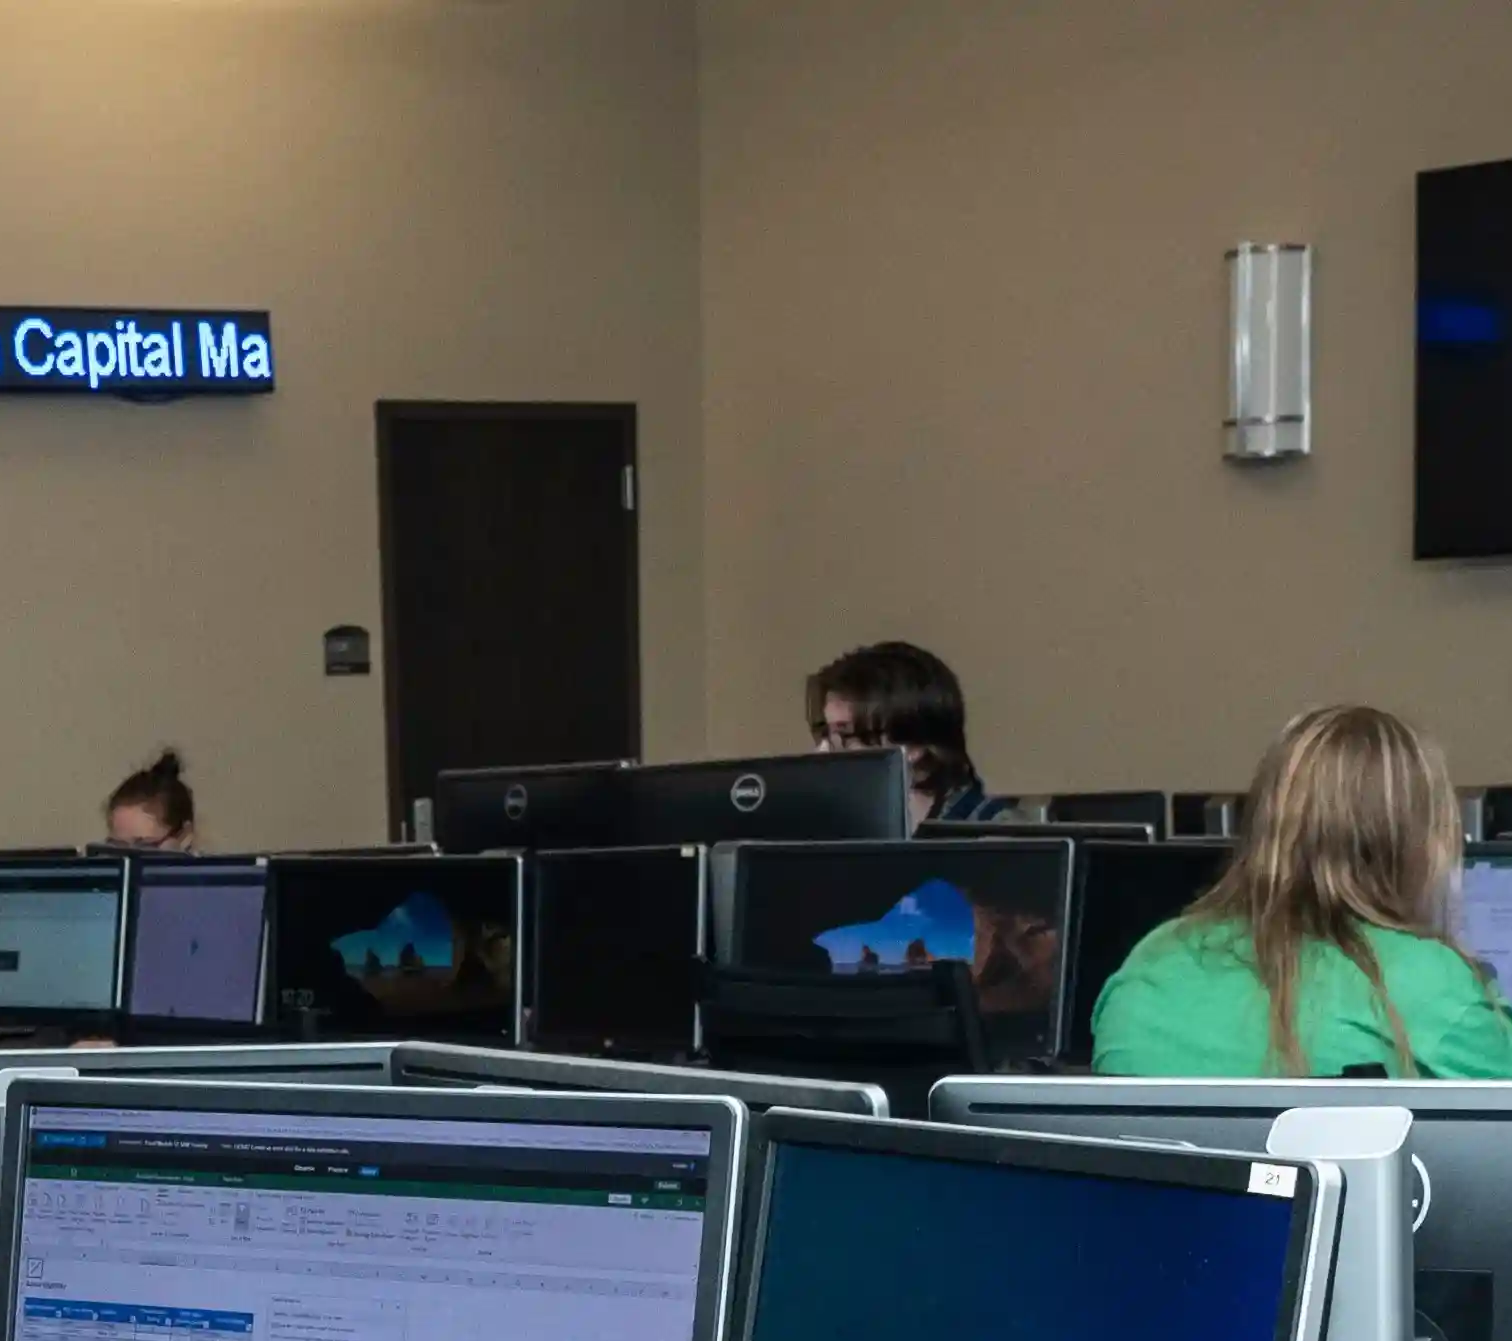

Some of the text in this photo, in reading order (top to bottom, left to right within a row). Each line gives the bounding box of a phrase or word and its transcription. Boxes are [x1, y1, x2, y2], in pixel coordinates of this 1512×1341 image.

[14, 317, 185, 389] Capital
[199, 320, 272, 379] Ma
[1265, 1172, 1280, 1186] 21
